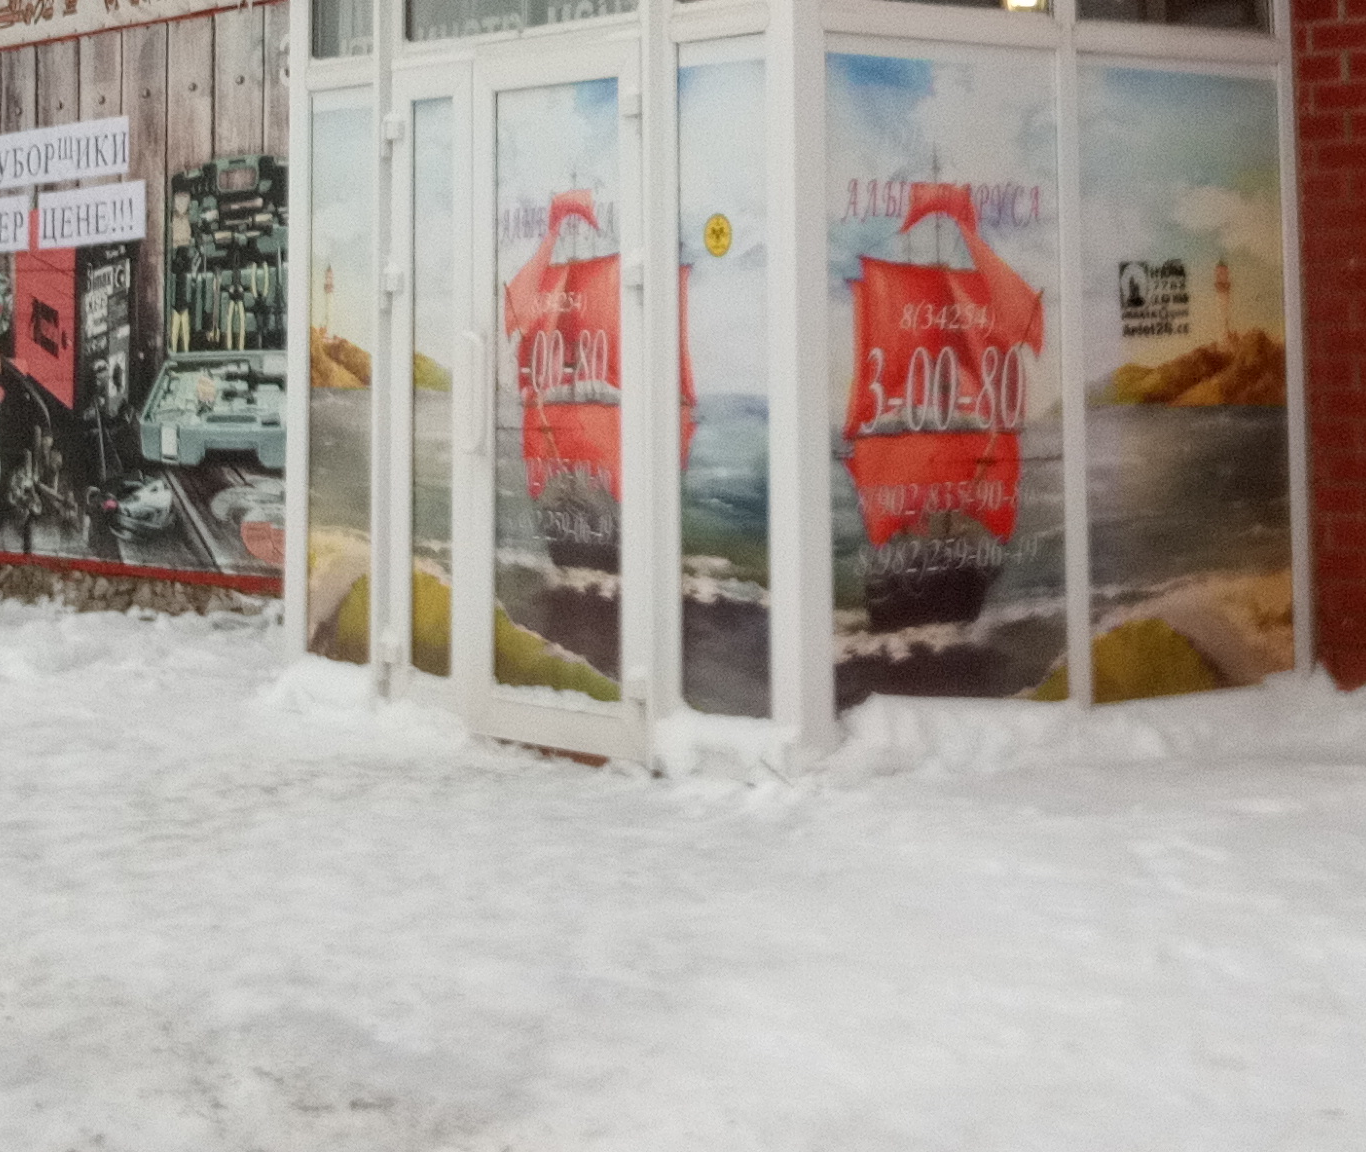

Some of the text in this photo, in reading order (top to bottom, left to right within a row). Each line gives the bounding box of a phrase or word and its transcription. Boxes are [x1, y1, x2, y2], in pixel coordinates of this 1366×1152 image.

[41, 198, 135, 241] ЦЕНЕ!!!
[937, 179, 1041, 229] РУСА
[862, 346, 1028, 433] 3-00-80
